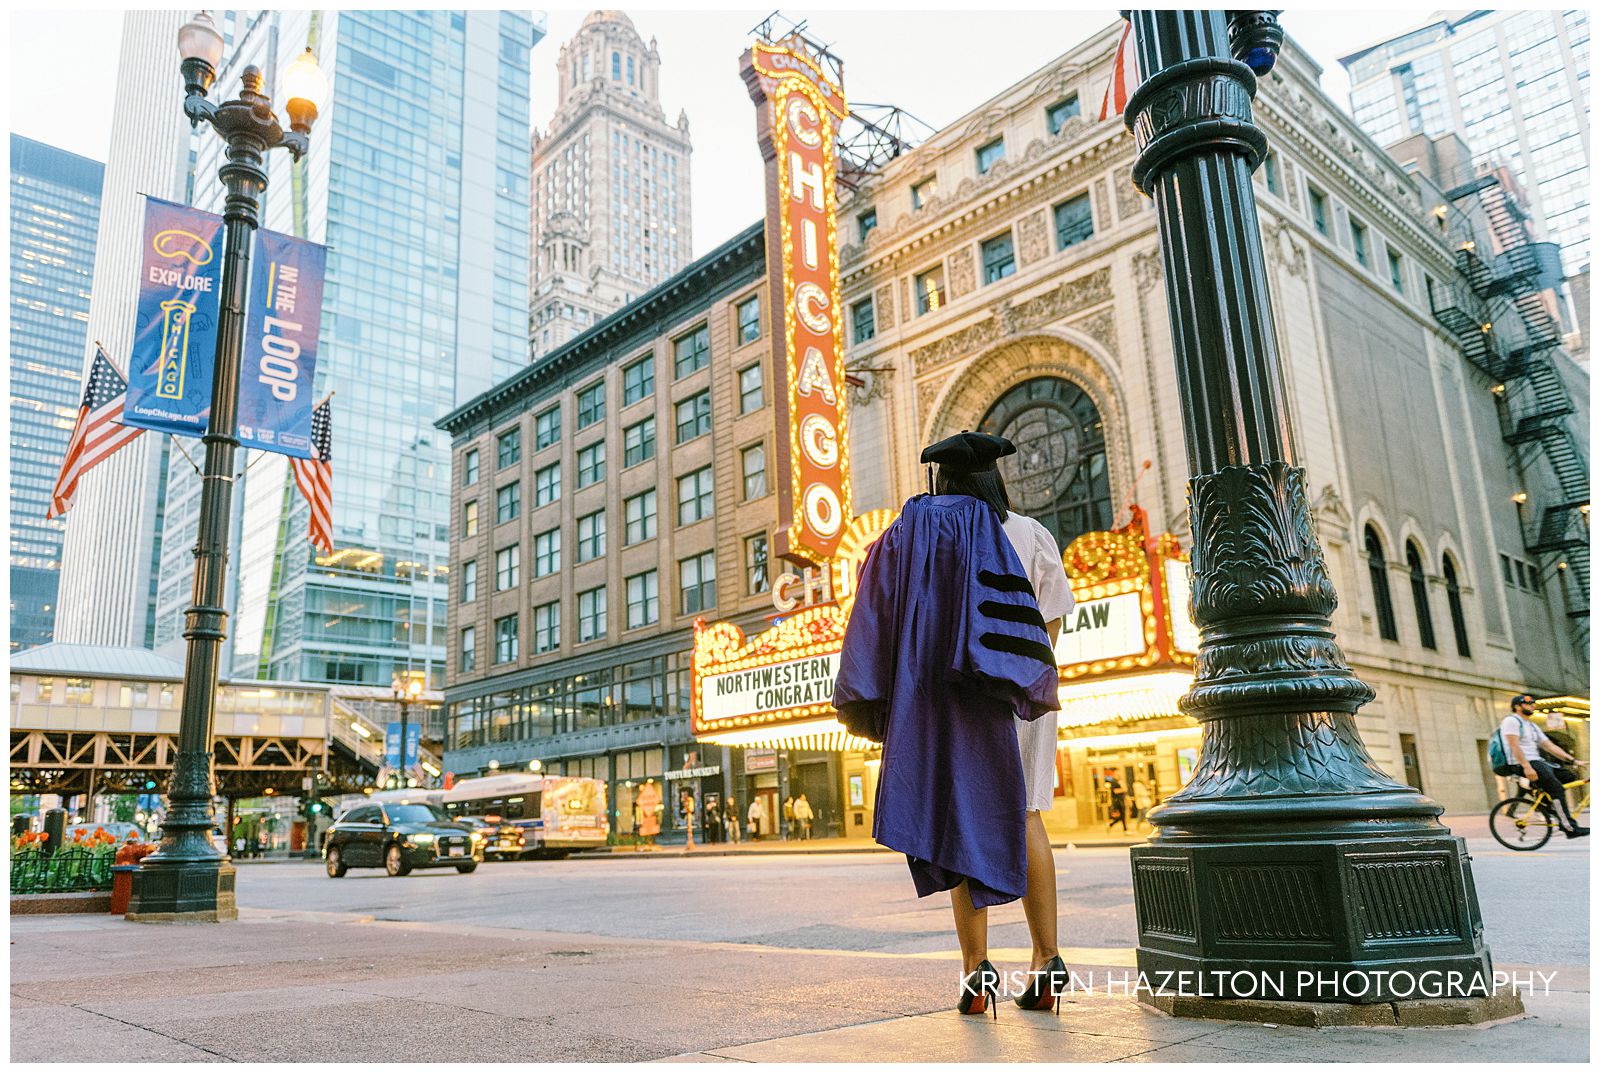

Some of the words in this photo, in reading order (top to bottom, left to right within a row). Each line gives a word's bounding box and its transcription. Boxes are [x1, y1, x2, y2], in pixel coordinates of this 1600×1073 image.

[149, 265, 213, 292] EXPLORE
[279, 264, 299, 284] IN
[275, 285, 297, 314] THE
[786, 96, 843, 540] CHICAGO
[163, 312, 182, 393] CHICAGO
[259, 315, 303, 402] LOOP
[134, 405, 199, 424] LoopChicago.com
[1062, 601, 1110, 635] LAW
[716, 656, 831, 697] NORTHWESTERN
